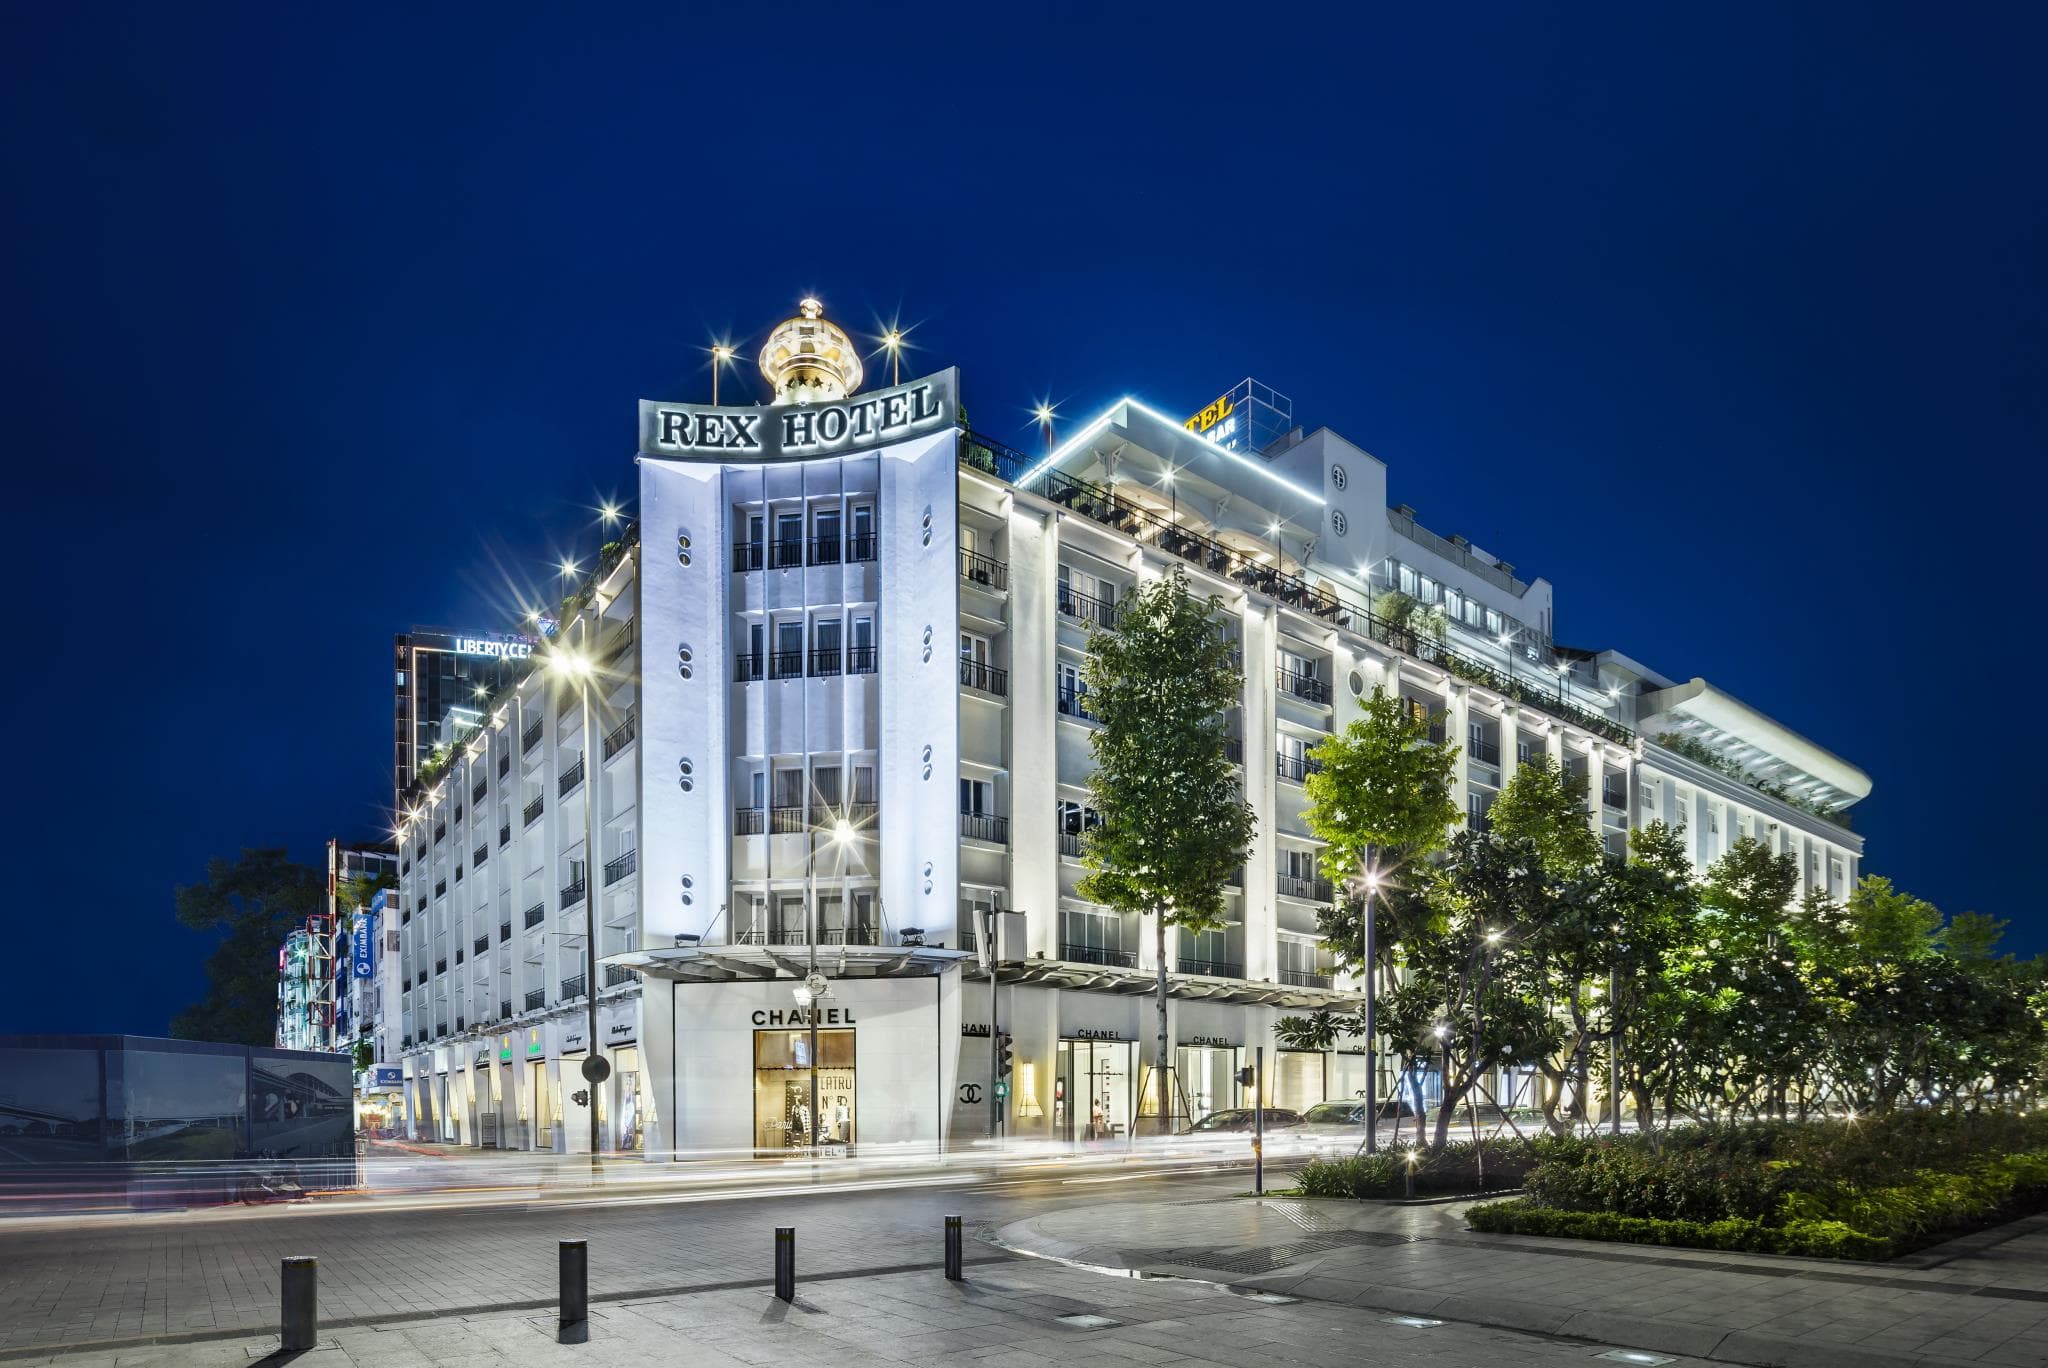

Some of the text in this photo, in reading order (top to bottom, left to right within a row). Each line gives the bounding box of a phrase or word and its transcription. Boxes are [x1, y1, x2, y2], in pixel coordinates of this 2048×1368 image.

[659, 385, 940, 448] REX HOTEL
[752, 1008, 856, 1025] CHANEL
[961, 1023, 1001, 1034] HANL
[1078, 1029, 1121, 1040] CHANEL
[1193, 1035, 1229, 1046] CHANEL
